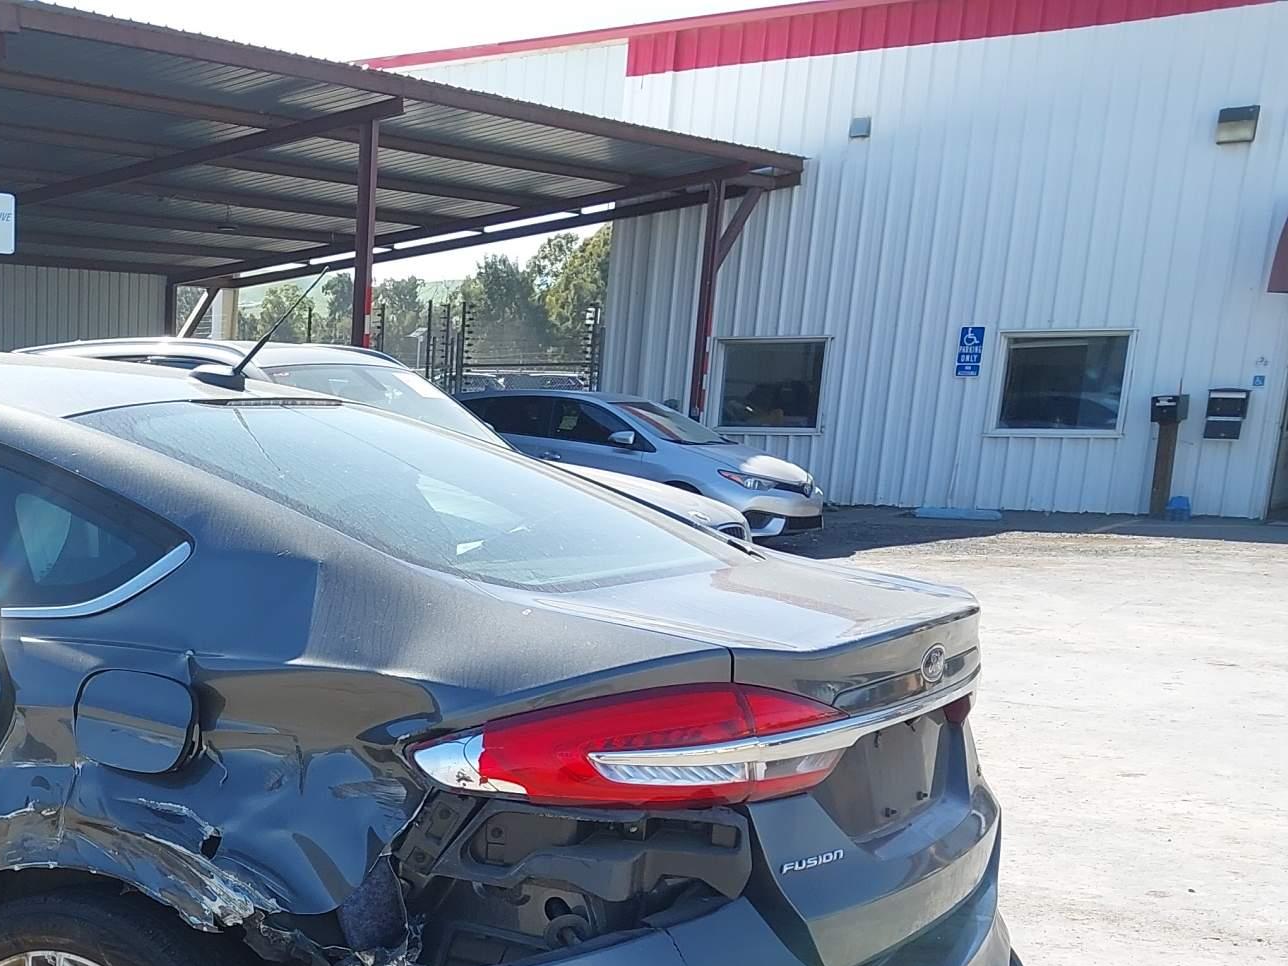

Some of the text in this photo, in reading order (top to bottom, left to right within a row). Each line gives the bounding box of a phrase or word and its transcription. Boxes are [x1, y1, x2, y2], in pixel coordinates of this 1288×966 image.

[959, 345, 983, 354] PARKING
[960, 354, 978, 363] ONLY
[781, 849, 844, 875] FUSION
